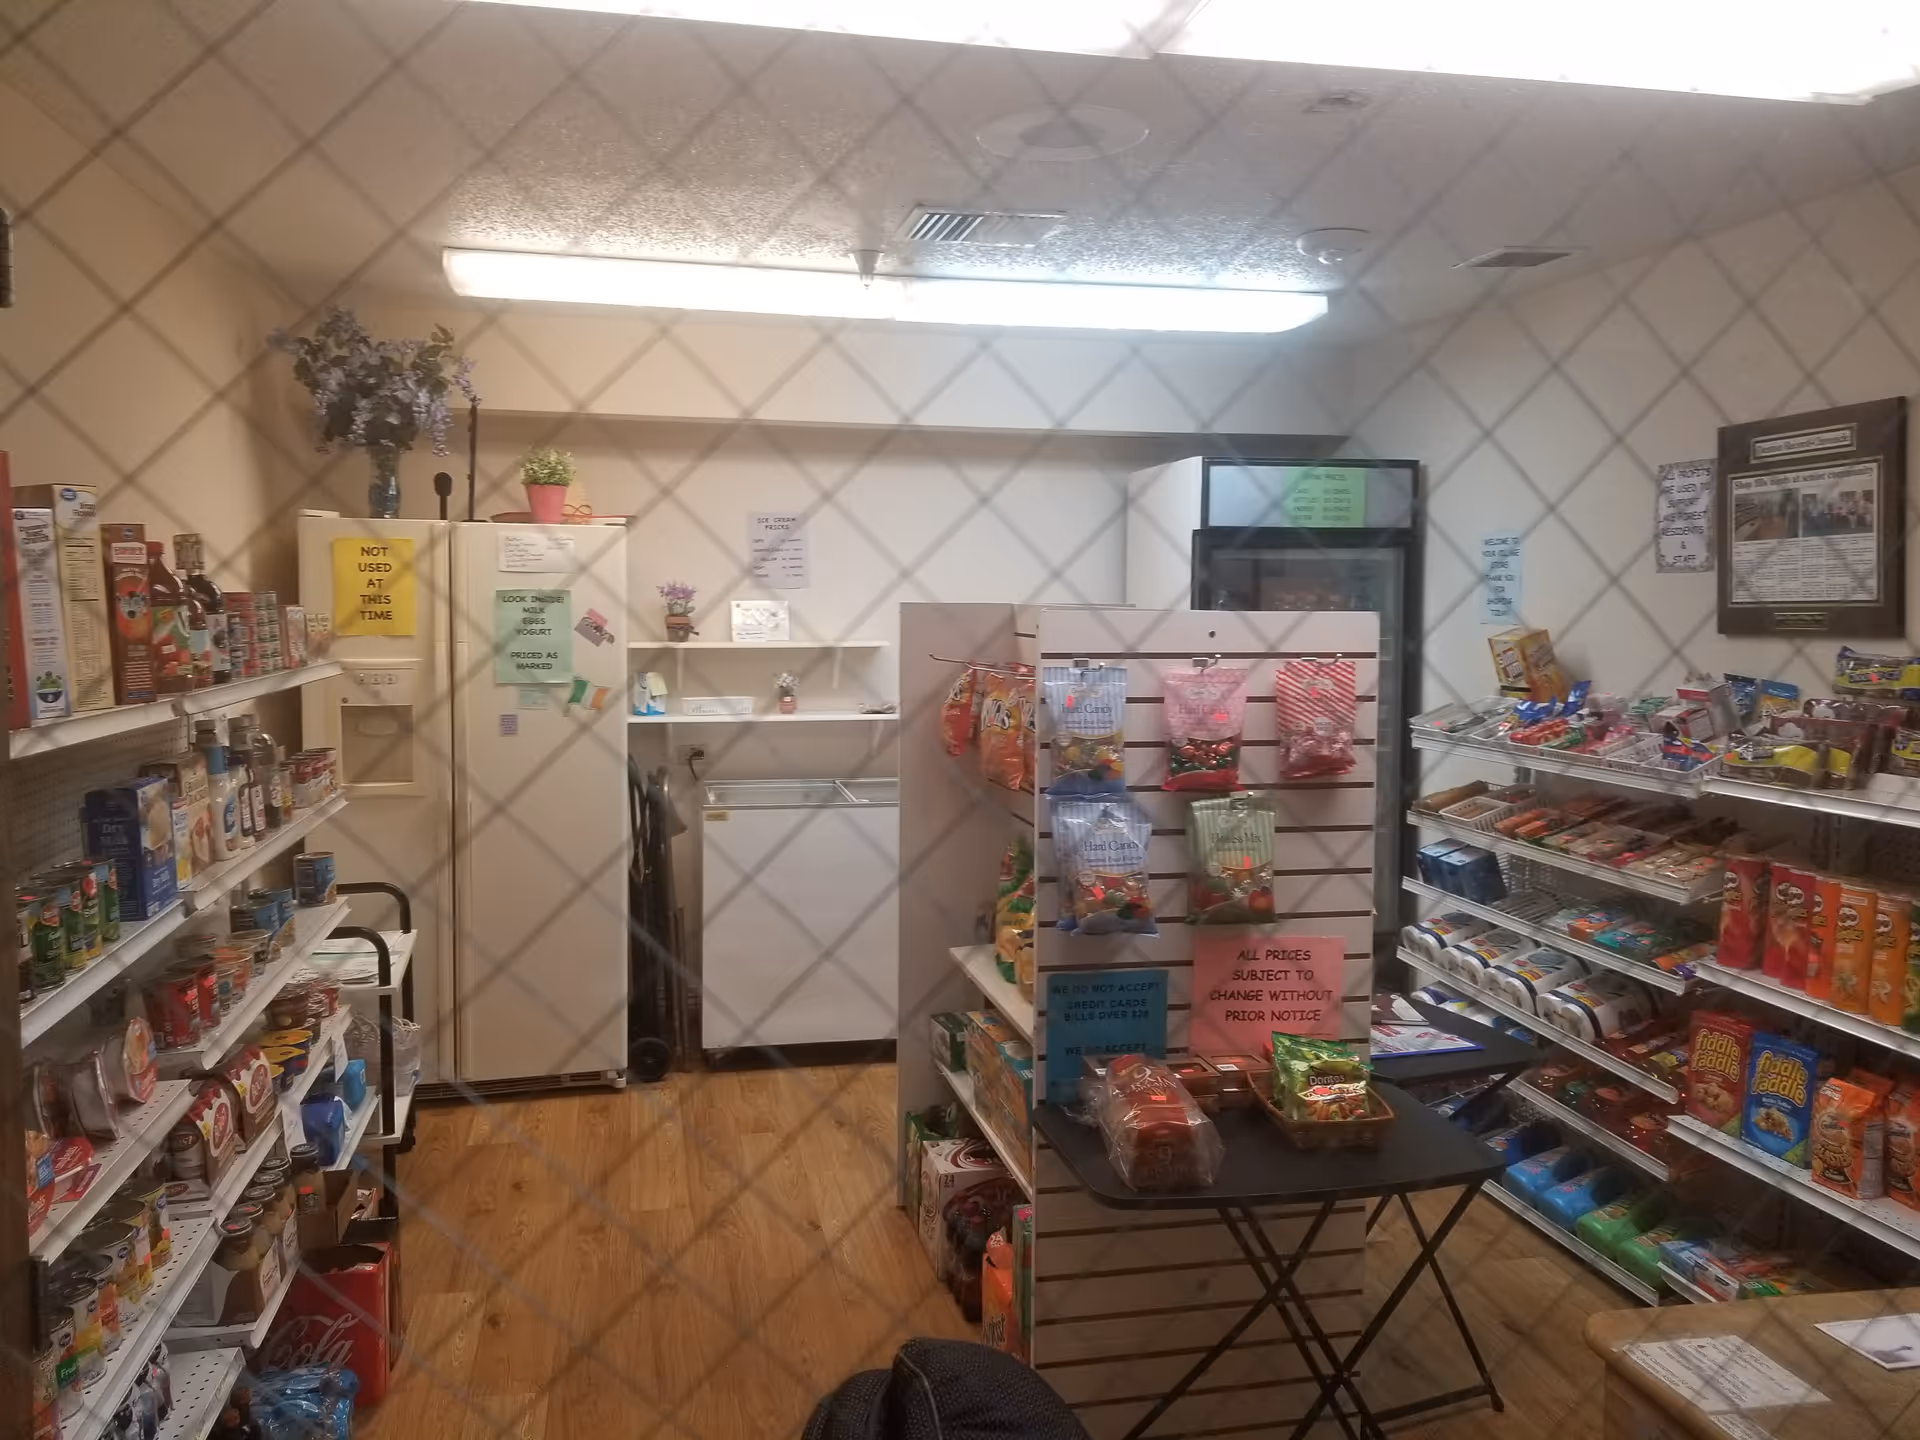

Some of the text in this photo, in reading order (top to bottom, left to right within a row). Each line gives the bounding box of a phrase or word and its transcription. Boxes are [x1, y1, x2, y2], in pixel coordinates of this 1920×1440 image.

[1661, 525, 1705, 537] RESIDENTS
[360, 547, 389, 557] NOT
[357, 562, 393, 573] USED
[366, 578, 385, 589] AT
[359, 594, 392, 605] THIS
[502, 595, 528, 603] LOOK
[359, 610, 393, 621] TIME
[522, 606, 546, 614] MILK
[521, 617, 546, 625] EGGS
[515, 628, 553, 636] YOGURT
[510, 651, 559, 660] PRICED AS
[516, 662, 553, 671] MARKED
[1084, 703, 1114, 716] Candy
[1083, 840, 1140, 853] Hard Candy
[1237, 949, 1312, 961] ALL PRICES
[1232, 969, 1314, 981] SUBJECT TO
[1052, 984, 1070, 994] WE
[1091, 983, 1115, 993] NOT
[1117, 981, 1161, 993] ACCEPT
[1209, 989, 1334, 1001] CHANGE WITHOUT
[1067, 998, 1147, 1010] CREDIT CARDS
[1064, 1011, 1096, 1021] BILLS
[1098, 1010, 1128, 1019] OVER
[1225, 1009, 1323, 1021] PRIOR NOTICE
[1065, 1046, 1081, 1056] WE
[1309, 1074, 1345, 1086] Doritos
